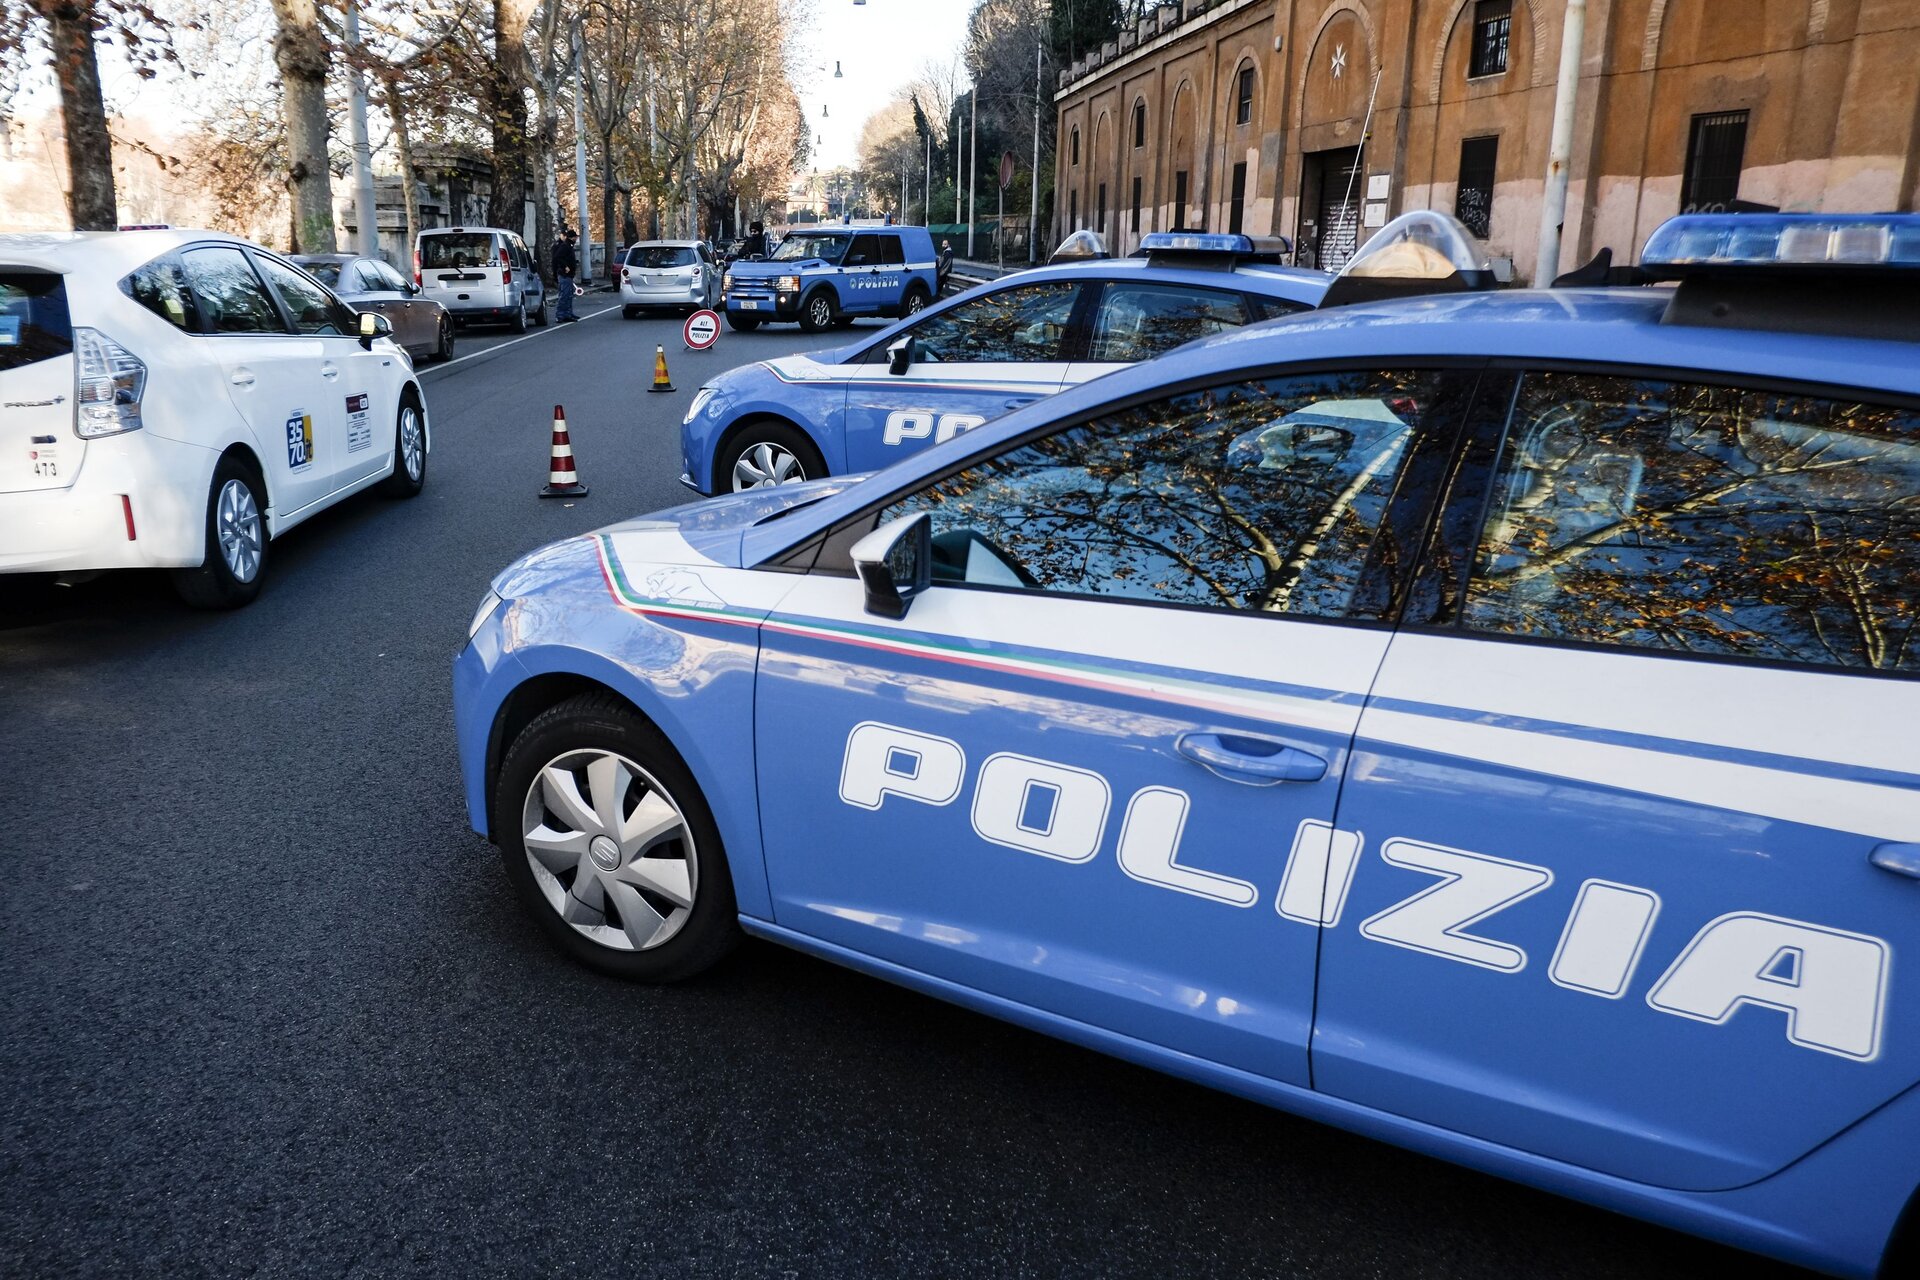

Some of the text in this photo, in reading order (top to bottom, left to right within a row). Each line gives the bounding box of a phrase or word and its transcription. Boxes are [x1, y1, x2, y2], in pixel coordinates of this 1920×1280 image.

[858, 275, 899, 289] POLIZIA
[288, 420, 303, 443] 35
[34, 462, 57, 477] 473
[838, 720, 1889, 1062] POLIZIA
